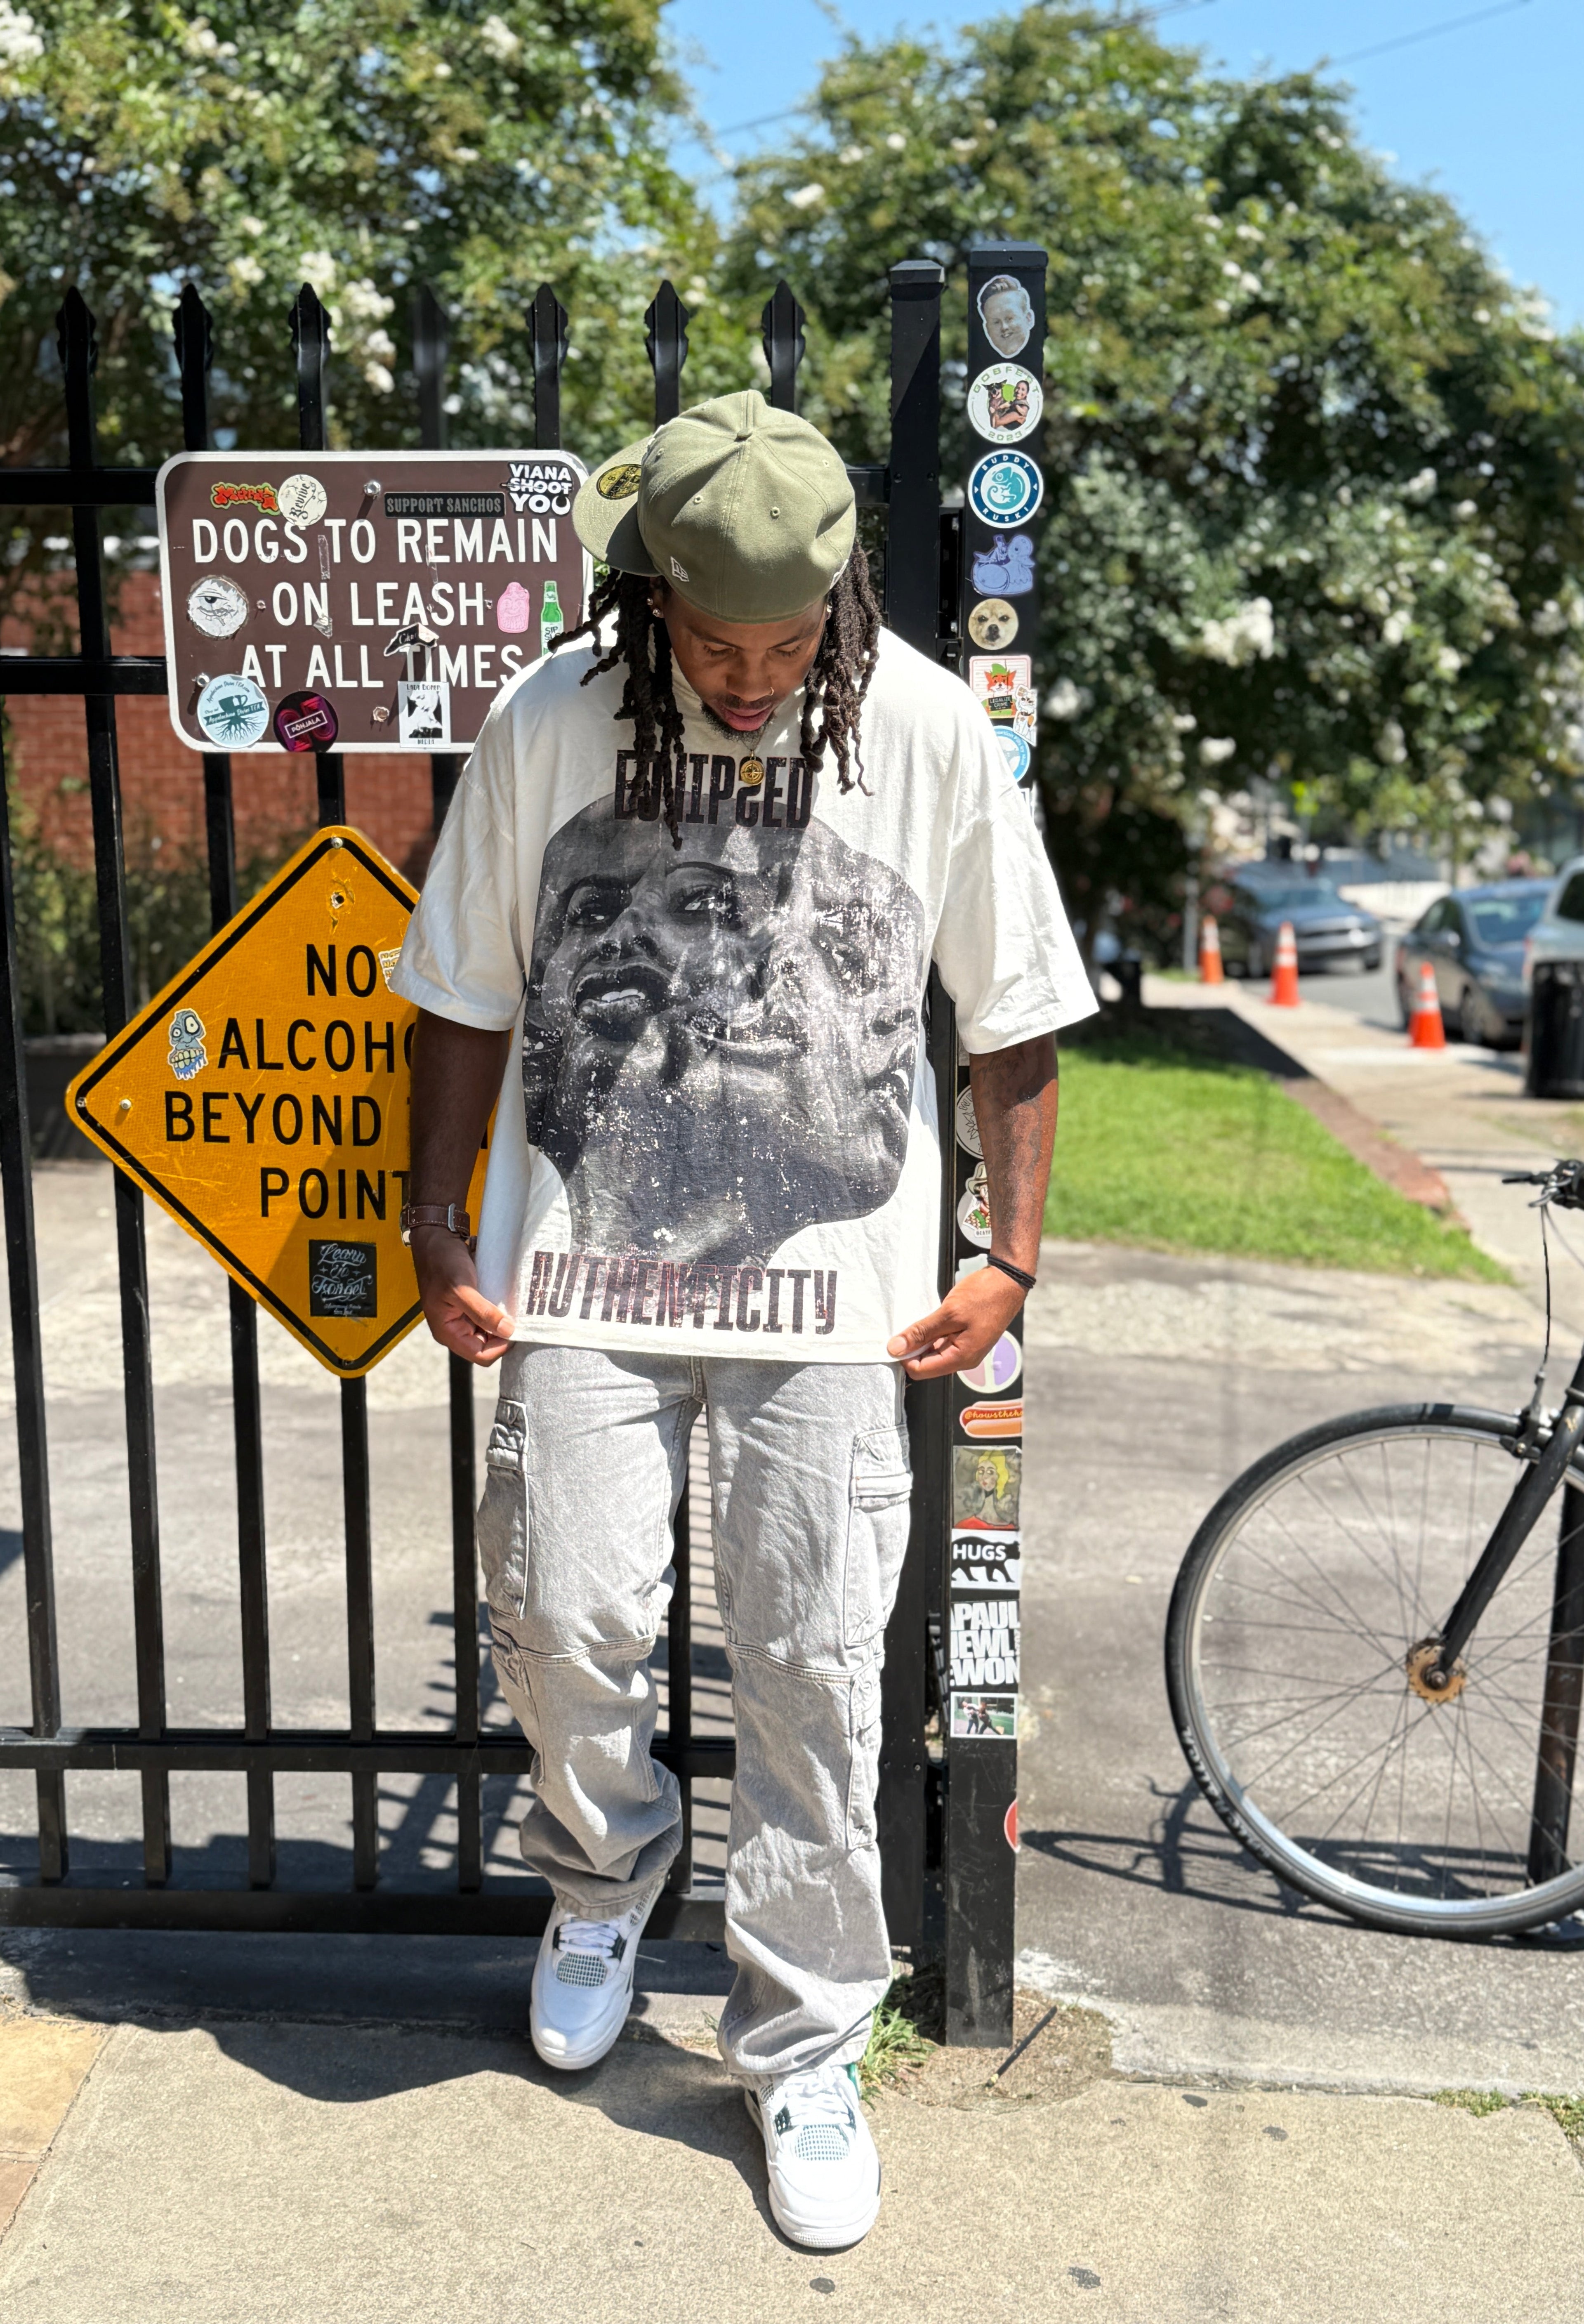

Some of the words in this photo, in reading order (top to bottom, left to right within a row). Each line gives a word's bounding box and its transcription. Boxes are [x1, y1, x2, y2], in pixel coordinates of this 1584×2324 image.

[973, 366, 1040, 393] GOBFEST
[988, 431, 1022, 441] 2023
[509, 464, 572, 481] VIANA
[982, 455, 1029, 471] BUDDY
[509, 478, 572, 494] SHOOT
[290, 482, 313, 519] Revive
[387, 498, 443, 513] SUPPORT
[447, 498, 501, 513] SANCHOS
[982, 507, 1029, 522] RUSKI
[193, 519, 308, 563] DOGS
[325, 519, 376, 563] TO
[398, 518, 557, 563] REMAIN
[273, 582, 329, 626] ON
[351, 582, 484, 626] LEASH
[545, 626, 558, 635] SIP
[241, 645, 287, 687] AT
[306, 645, 384, 688] ALL
[399, 644, 523, 688] TIMES
[306, 944, 377, 998] NO
[217, 1017, 414, 1074] ALCOH
[165, 1091, 382, 1147] BEYOND
[260, 1167, 410, 1220] POINT
[318, 1243, 366, 1266] Learn
[312, 1274, 373, 1301] Forget
[526, 1250, 838, 1335] AUTHENTICITY
[953, 1544, 1006, 1561] HUGS
